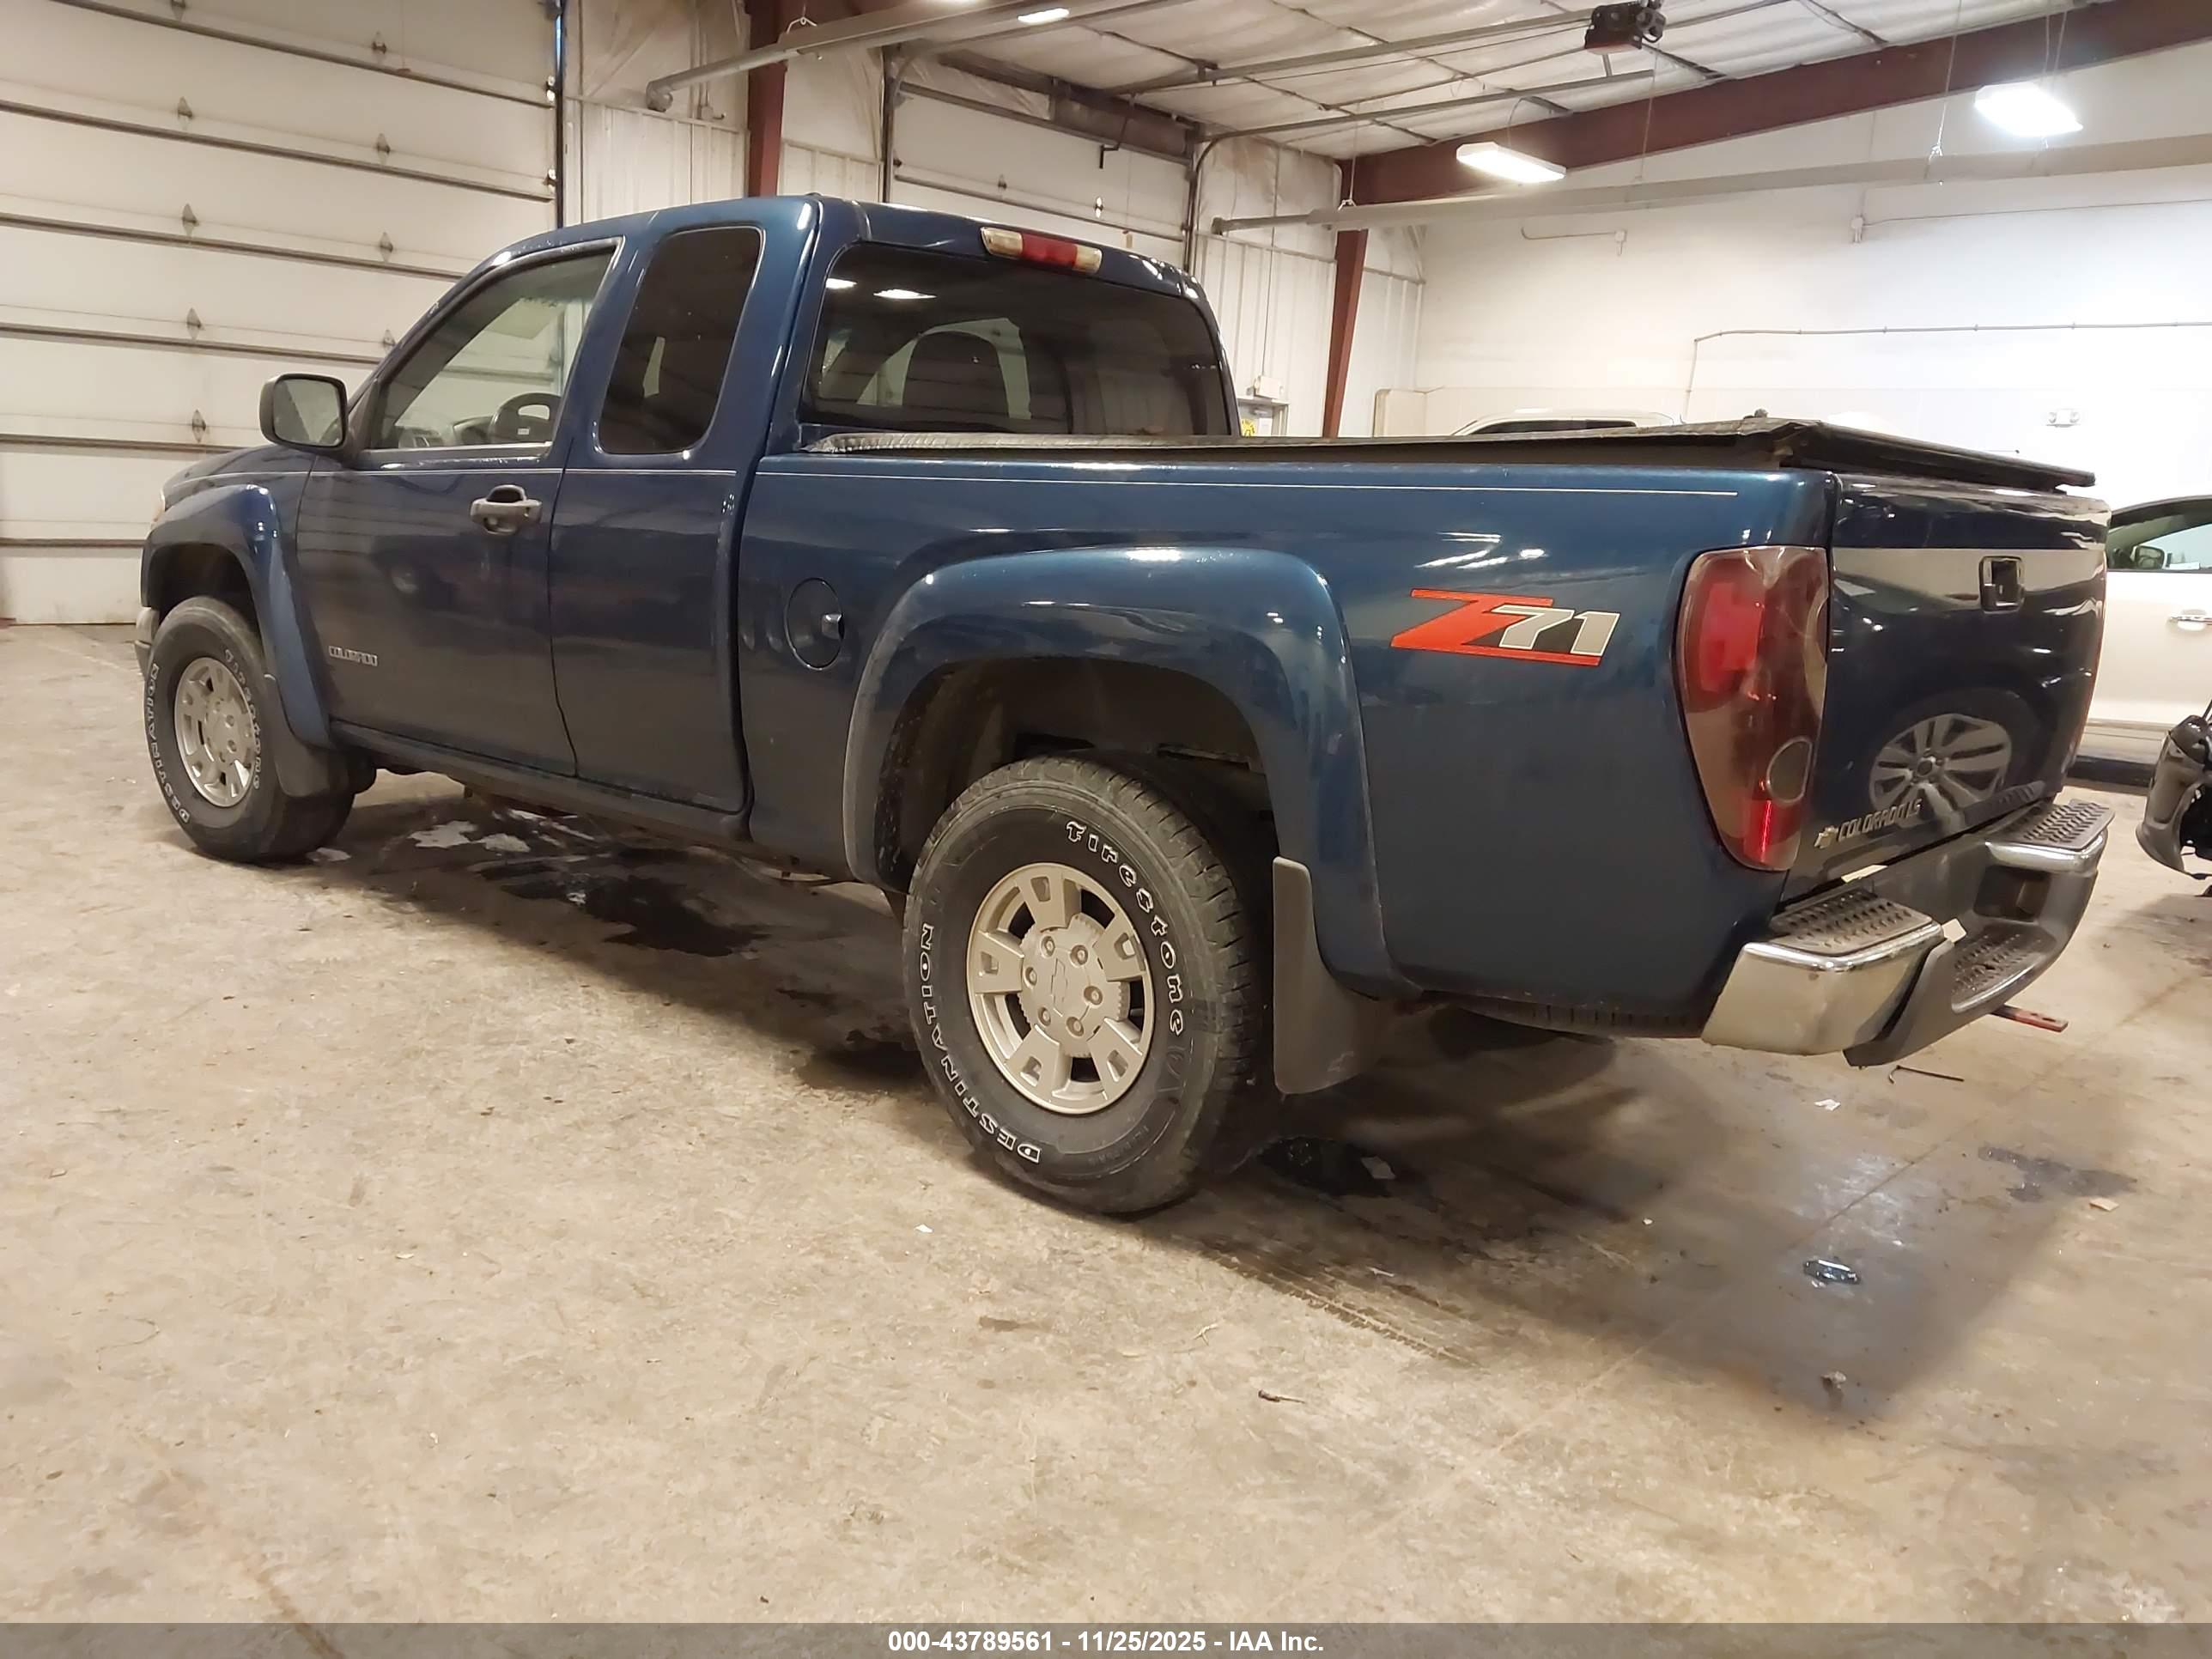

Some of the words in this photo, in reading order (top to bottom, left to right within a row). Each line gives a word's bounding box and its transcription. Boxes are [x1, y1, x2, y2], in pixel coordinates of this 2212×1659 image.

[1389, 587, 1621, 667] Z71
[144, 662, 191, 823] DESTINATION
[1838, 803, 1905, 842] COLORADO
[919, 922, 1042, 1164] DESTINATION
